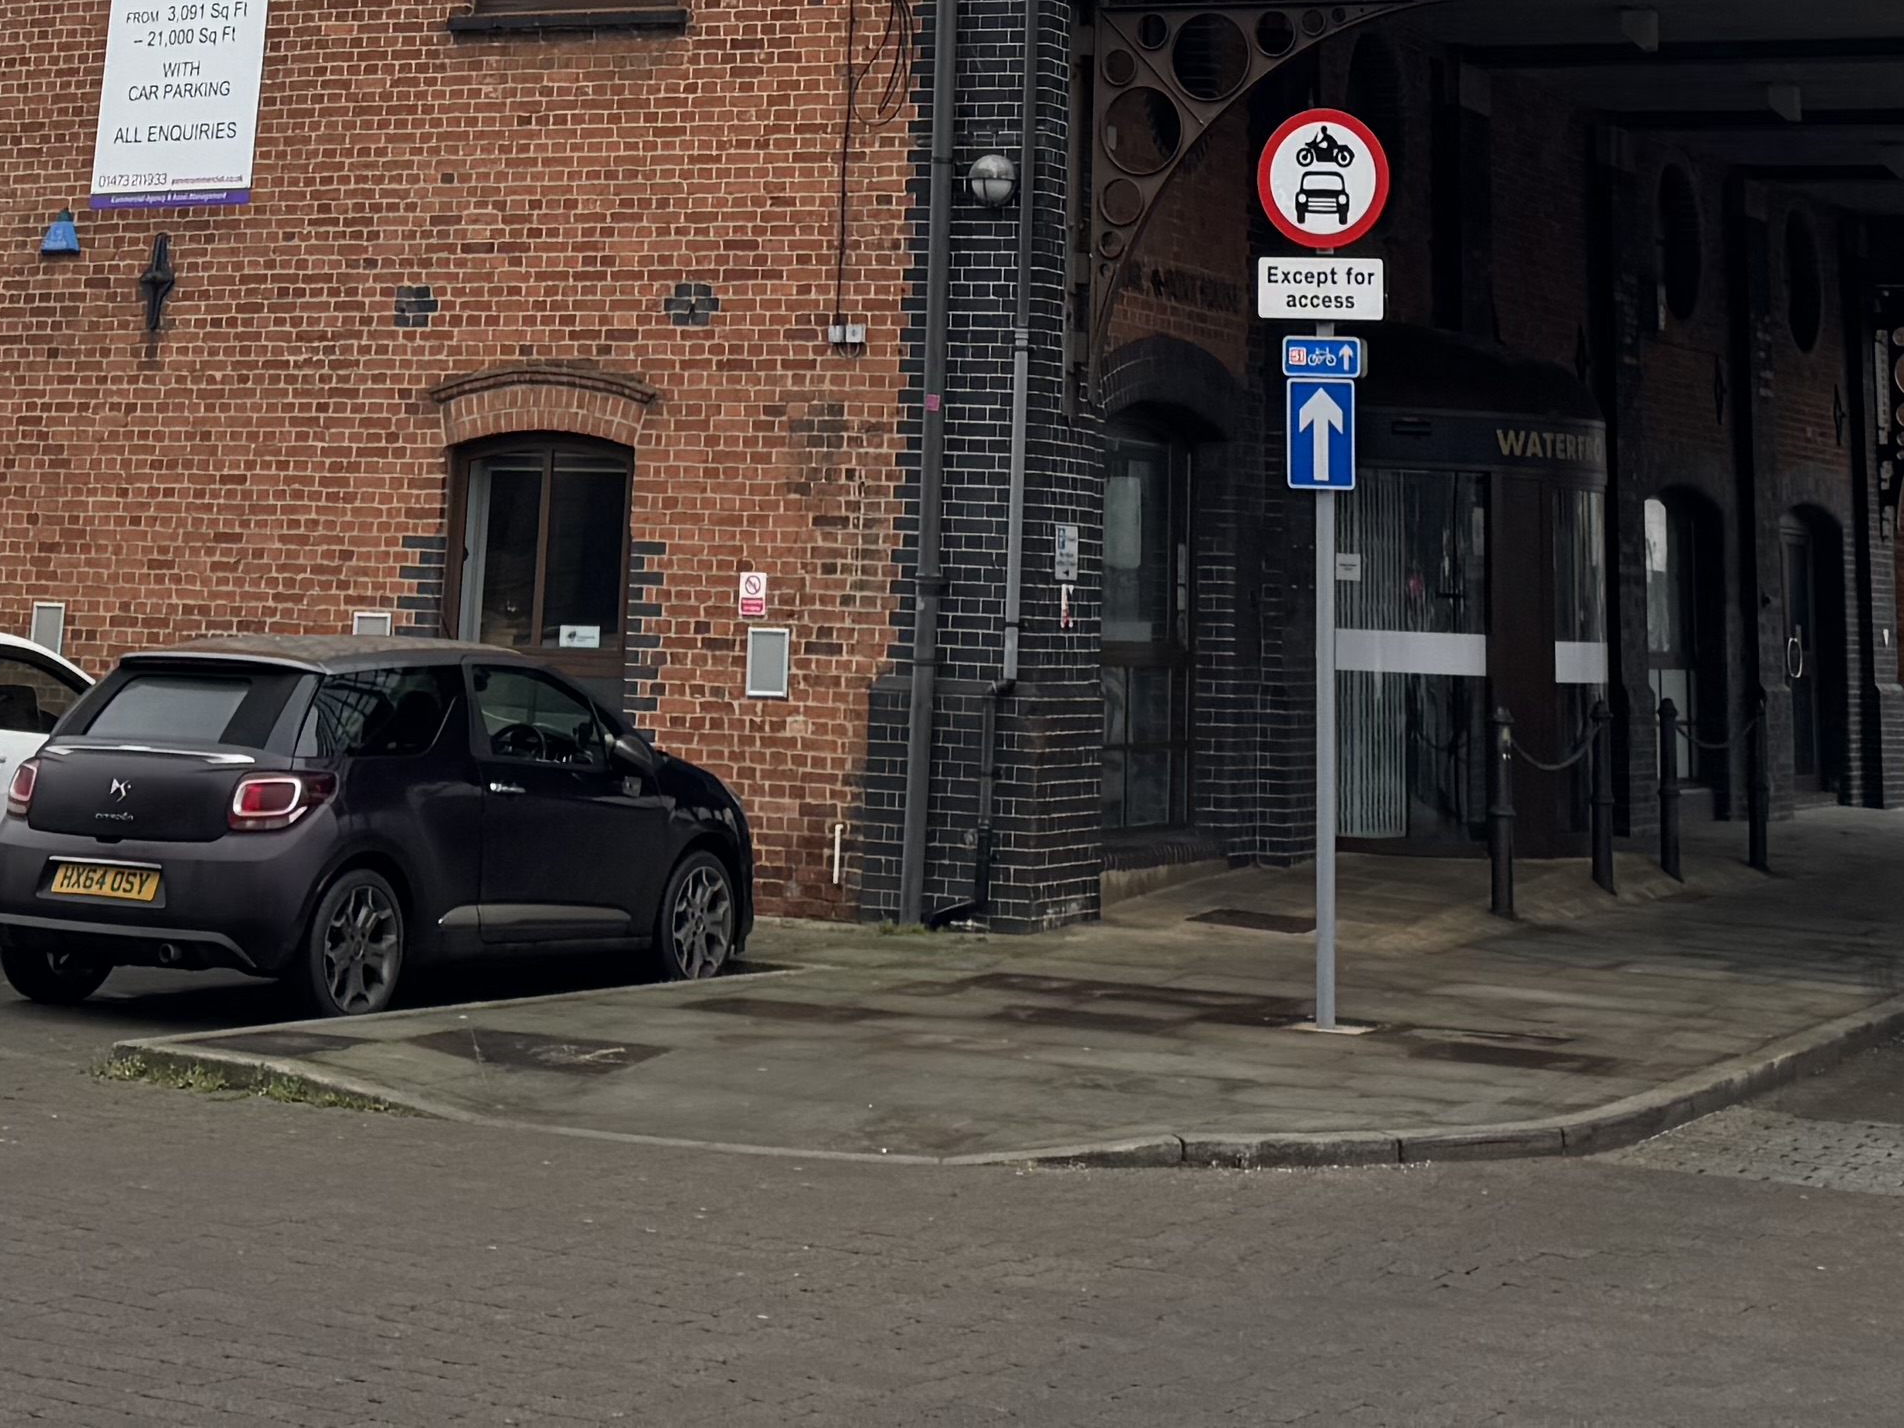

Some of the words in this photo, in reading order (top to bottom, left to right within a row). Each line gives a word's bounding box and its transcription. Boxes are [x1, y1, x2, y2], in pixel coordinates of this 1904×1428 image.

[126, 10, 160, 24] FROM
[167, 3, 205, 23] 3,091
[210, 2, 229, 21] Sq
[147, 28, 195, 47] 21,000
[198, 27, 218, 46] Sq
[162, 60, 201, 78] WITH
[128, 84, 159, 101] CAR
[163, 80, 231, 99] PARKING
[113, 126, 142, 144] ALL
[147, 122, 237, 142] ENQUIRIES
[1266, 266, 1338, 287] Except
[1346, 267, 1376, 286] for
[1285, 293, 1356, 310] access
[60, 866, 108, 890] HX64
